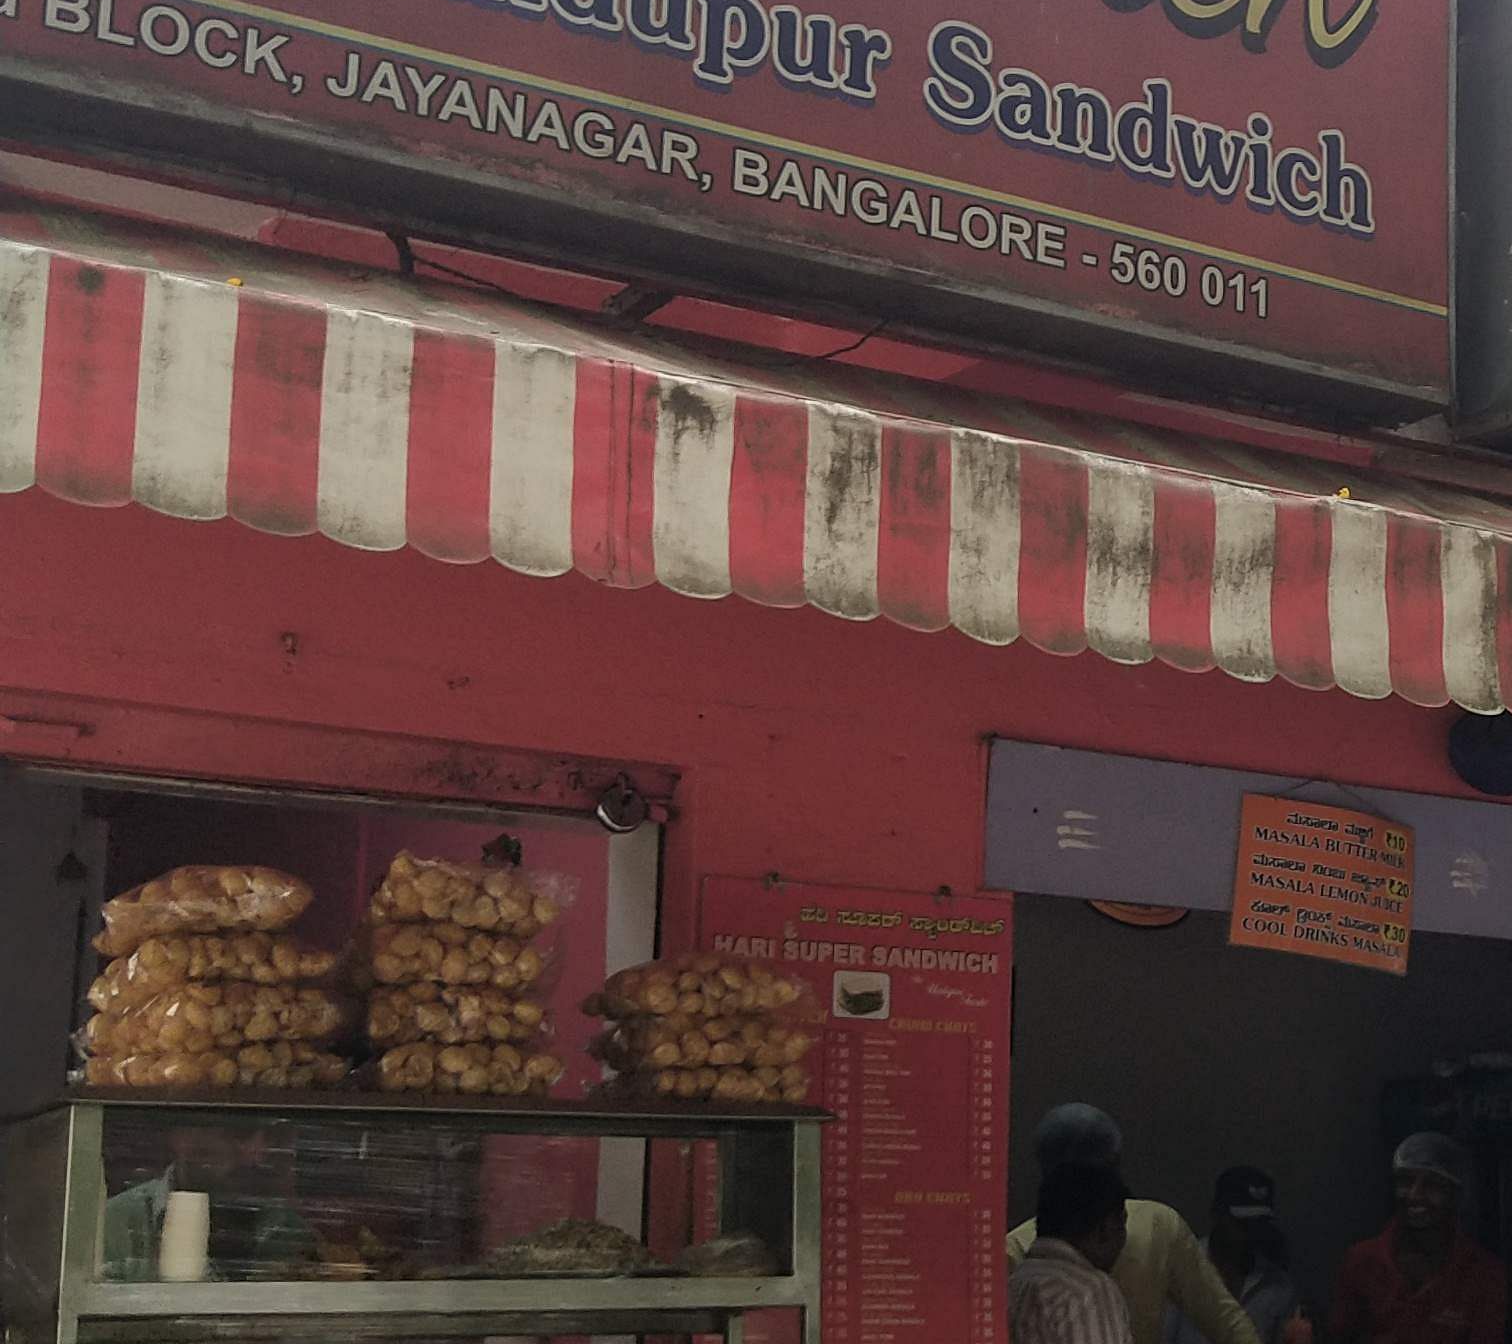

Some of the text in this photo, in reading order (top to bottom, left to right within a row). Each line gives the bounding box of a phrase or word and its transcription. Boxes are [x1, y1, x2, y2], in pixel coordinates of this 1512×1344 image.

[924, 20, 1377, 235] Sandwich
[325, 52, 712, 193] JAYANAGAR,
[732, 148, 1068, 270] BANGALORE
[1110, 243, 1186, 297] 560
[1201, 273, 1270, 318] 011
[1254, 826, 1320, 850] MASALA
[1250, 871, 1404, 914] MASALA LEMON JUICE
[1388, 878, 1410, 899] ₹20
[1242, 917, 1288, 937] COOL
[1293, 924, 1349, 948] DRINKS
[1383, 923, 1406, 944] ₹30
[714, 934, 1000, 975] HARI SUPER SANDWICH
